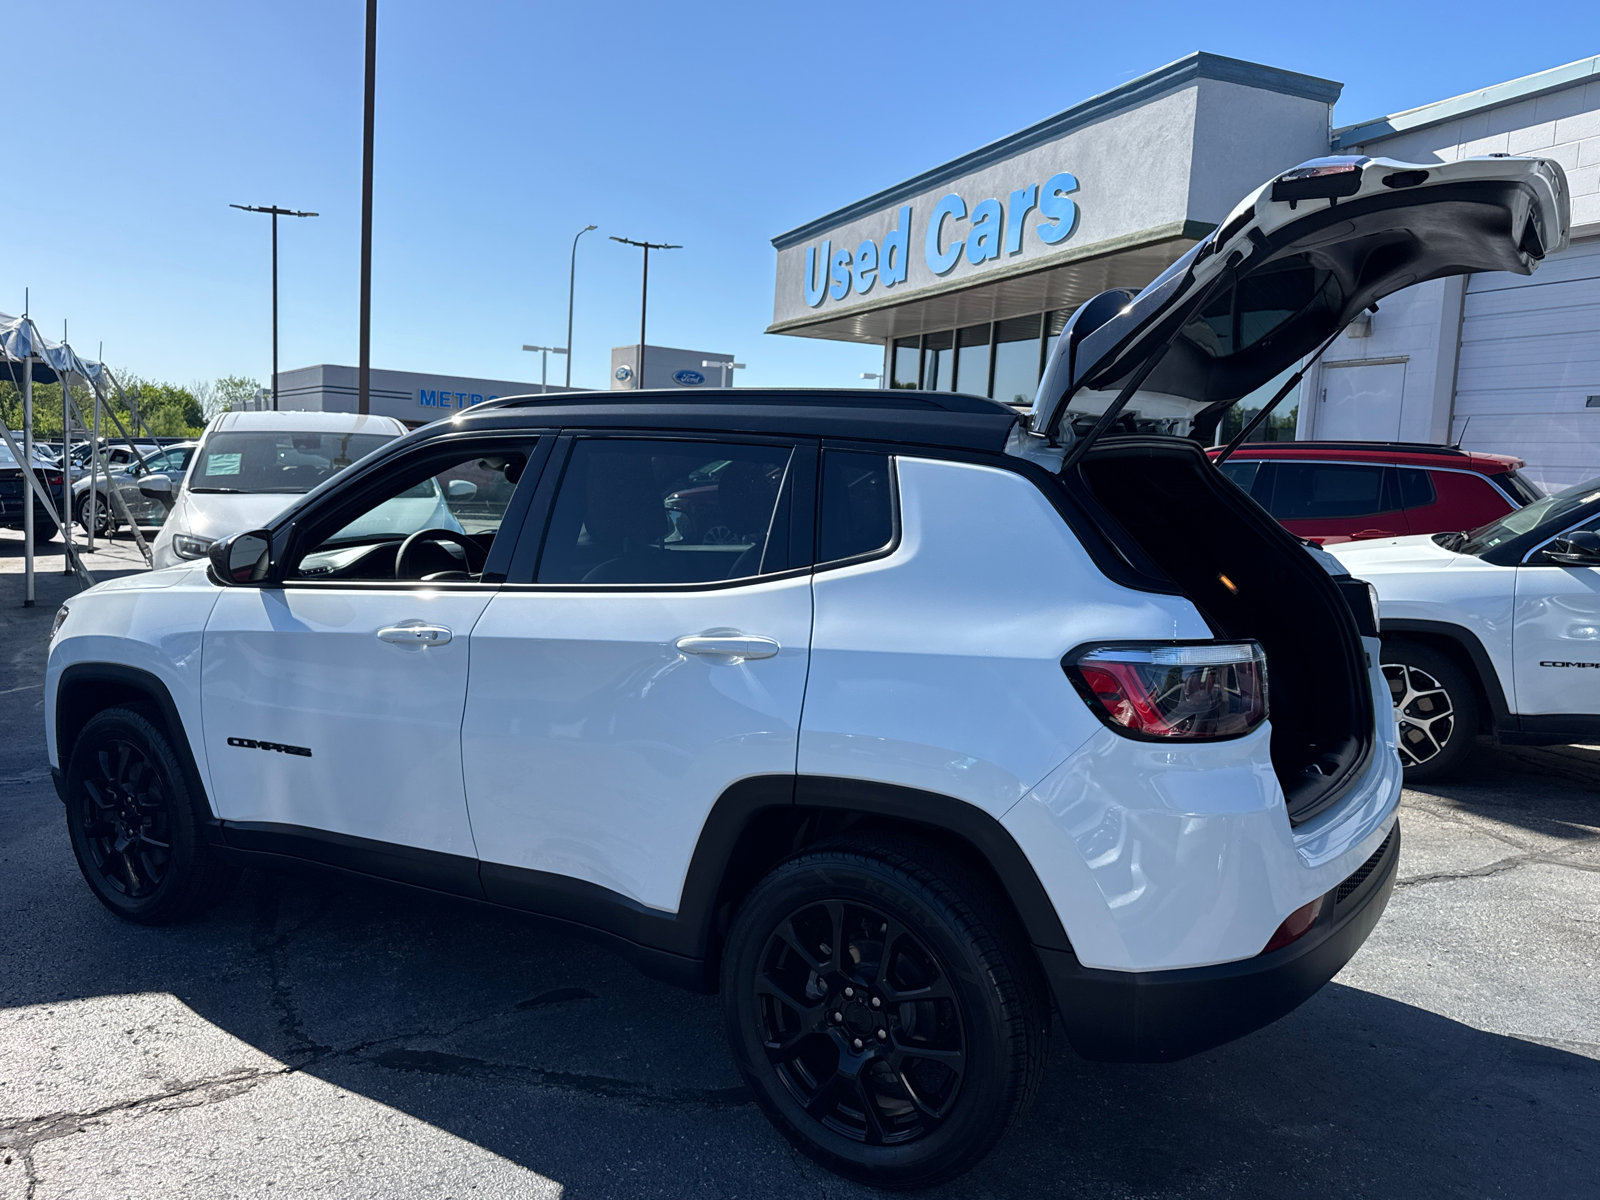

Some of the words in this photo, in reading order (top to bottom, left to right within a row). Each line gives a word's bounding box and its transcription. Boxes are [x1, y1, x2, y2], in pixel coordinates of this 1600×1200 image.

[803, 204, 912, 309] Used
[924, 171, 1081, 277] Cars
[419, 389, 499, 410] METR
